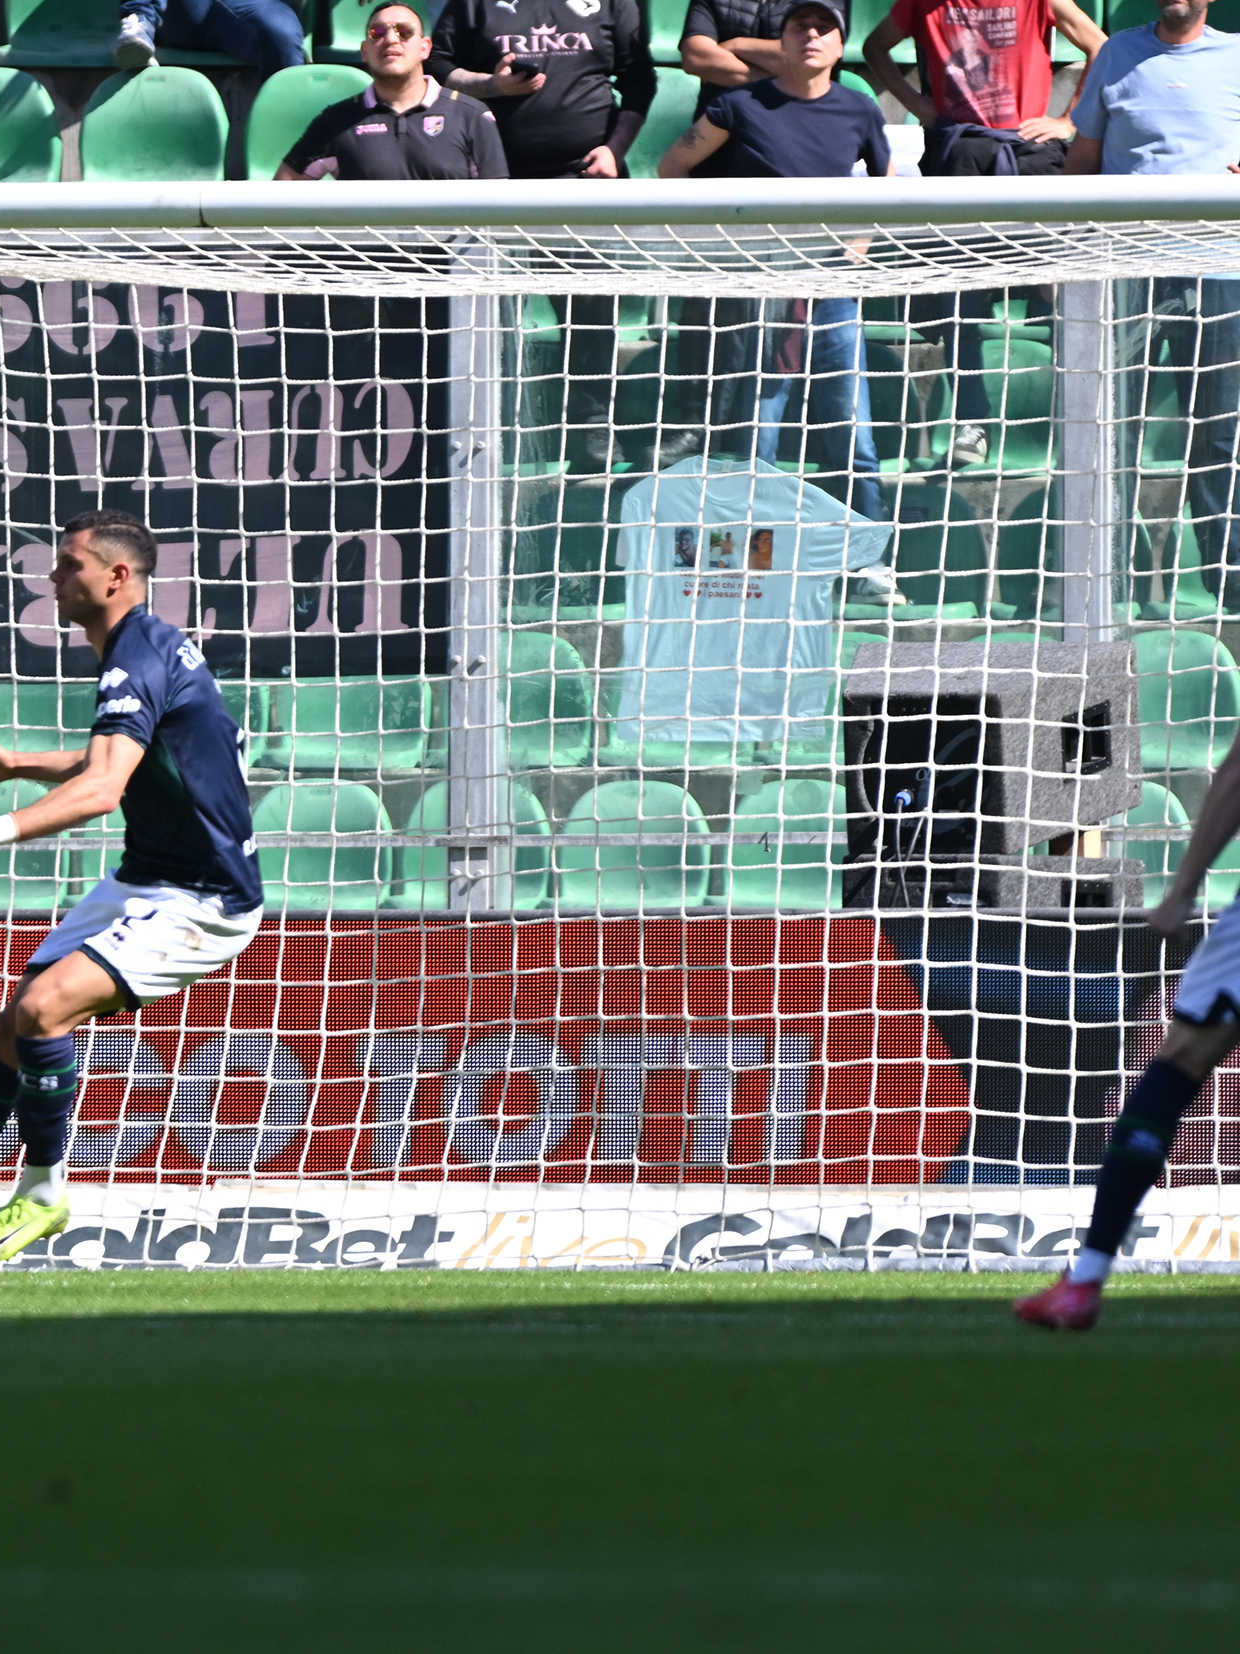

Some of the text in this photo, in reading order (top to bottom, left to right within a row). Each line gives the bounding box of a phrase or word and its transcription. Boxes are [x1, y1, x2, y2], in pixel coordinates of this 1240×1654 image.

[58, 377, 414, 492] CURVA
[737, 582, 760, 590] rsta
[355, 1033, 812, 1169] TOTTI
